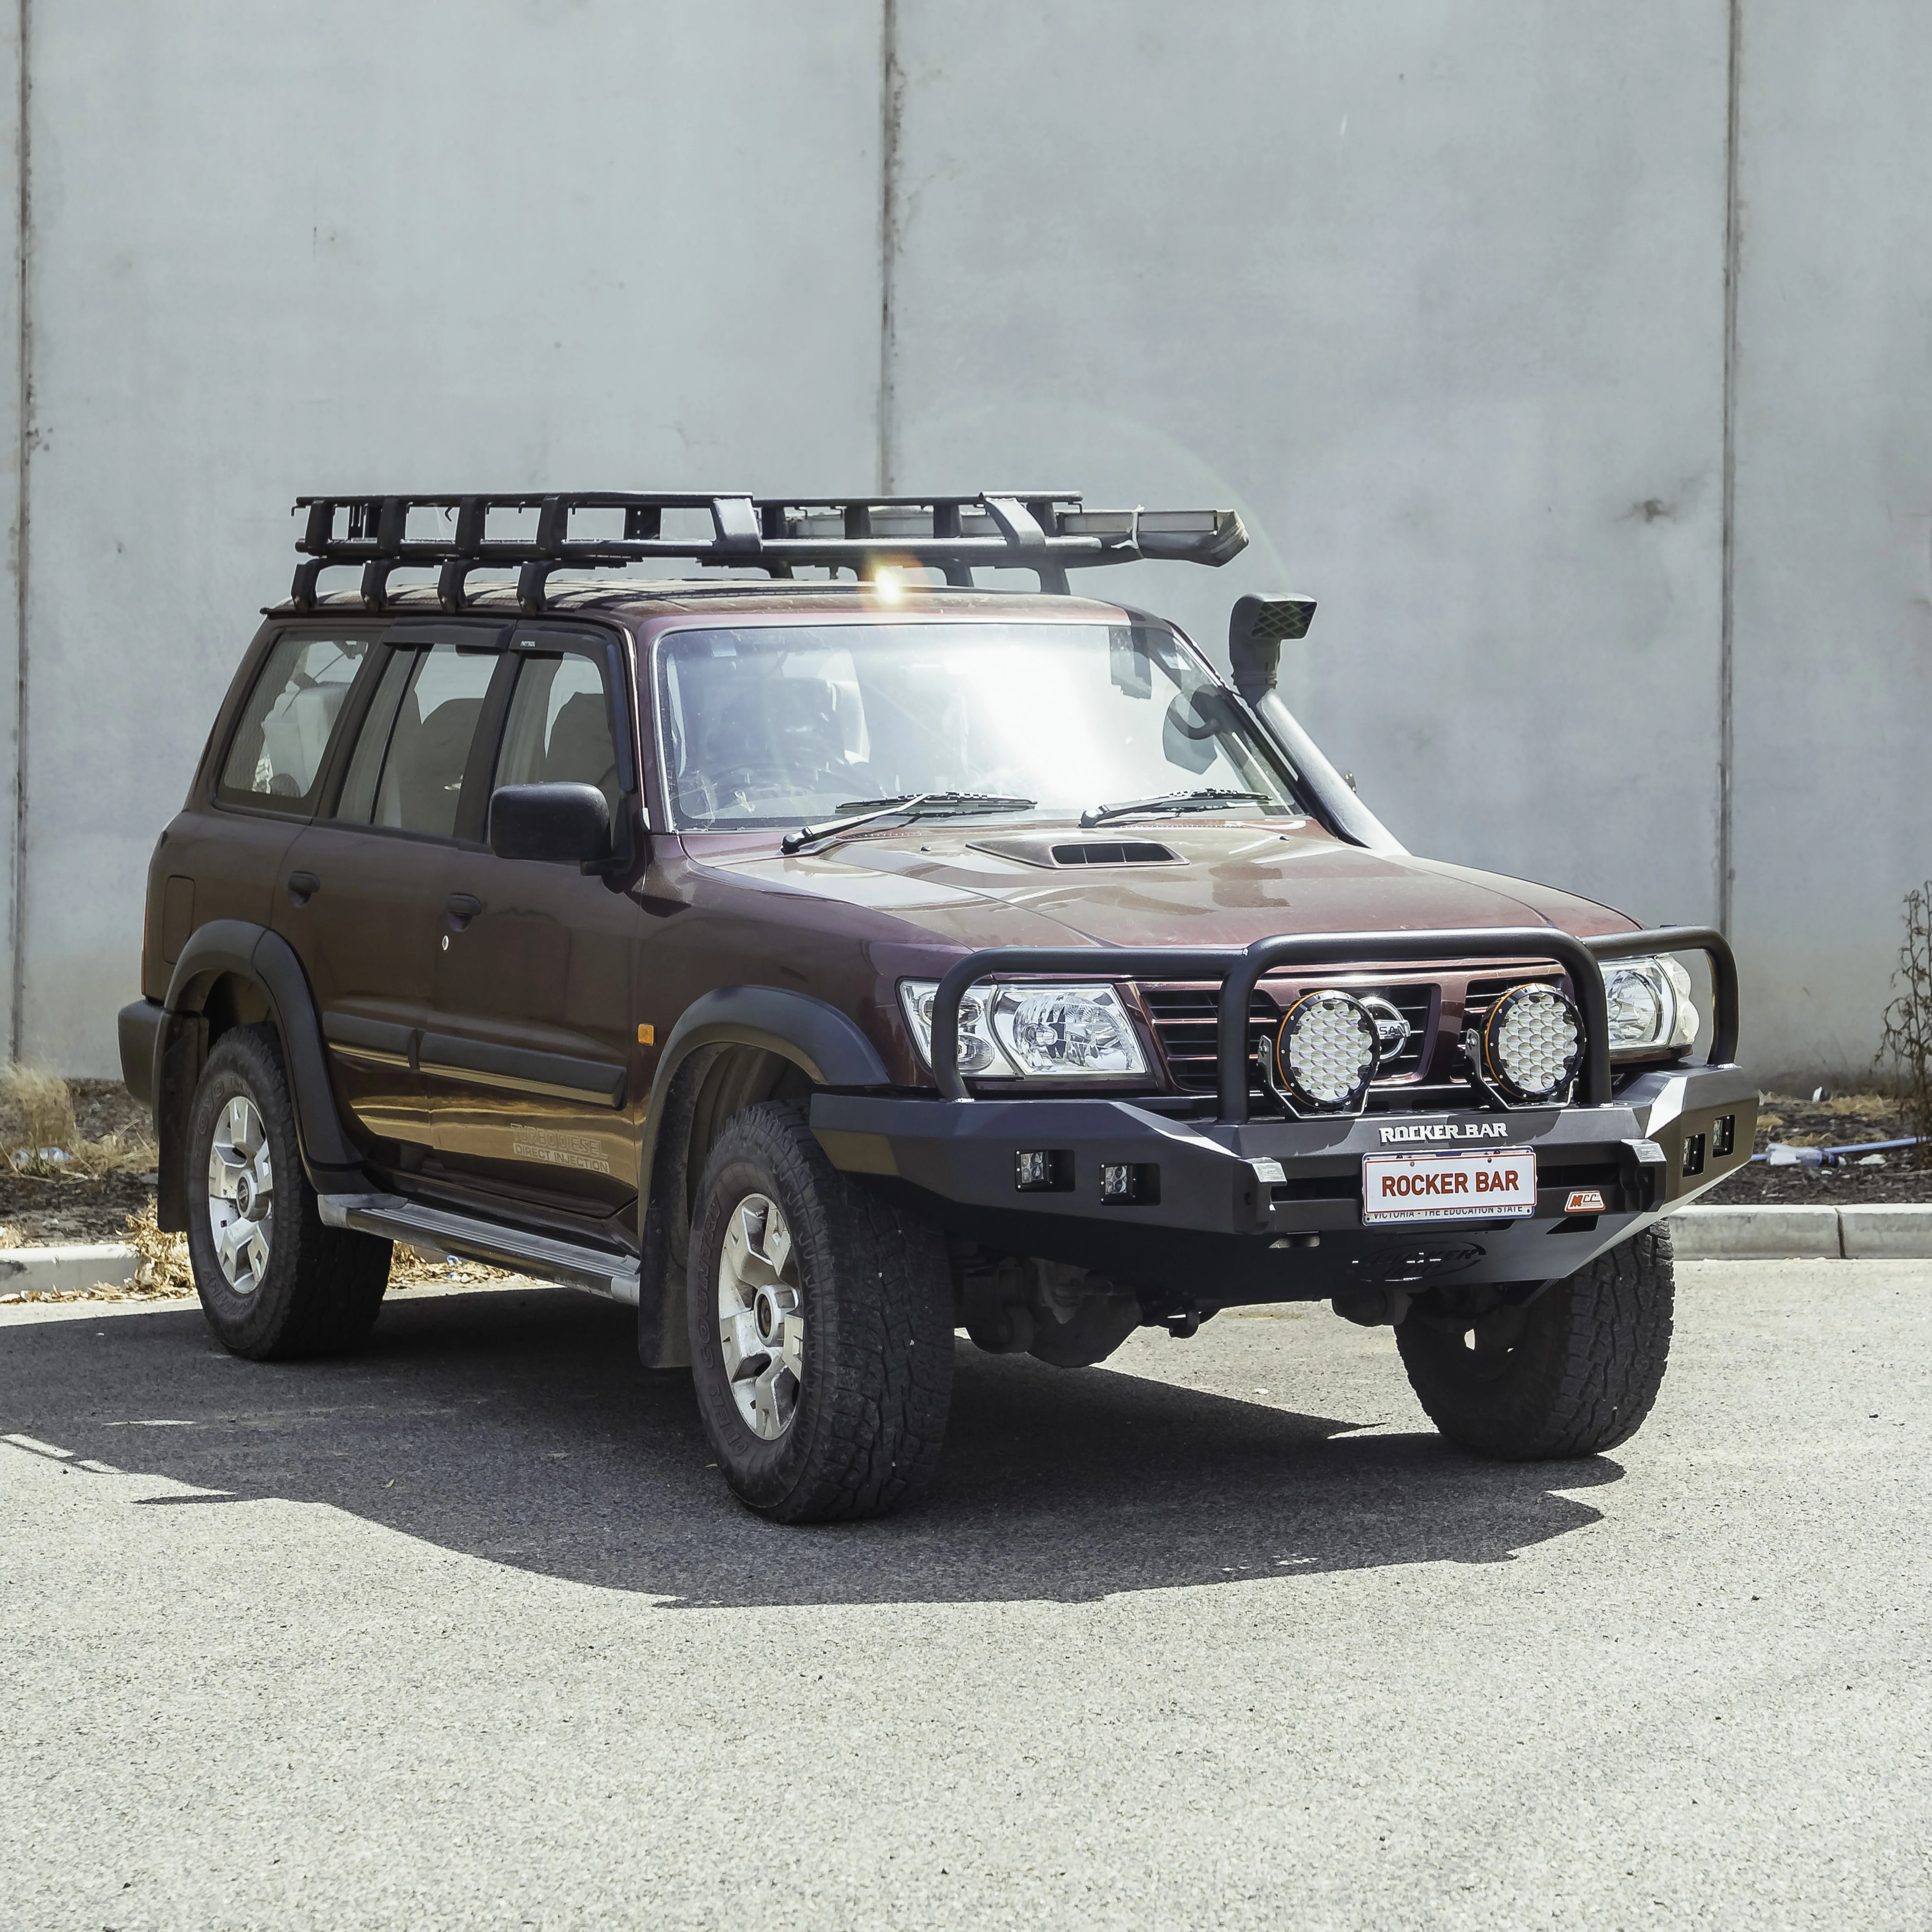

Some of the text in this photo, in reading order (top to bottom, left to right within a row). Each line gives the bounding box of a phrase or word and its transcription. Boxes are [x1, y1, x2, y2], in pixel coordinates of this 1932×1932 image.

[1379, 1122, 1509, 1143] ROCKER BAR
[515, 1144, 609, 1173] DIRECT INJECTION
[1382, 1170, 1519, 1197] ROCKER BAR
[697, 1191, 748, 1456] OPEN COUNTRY
